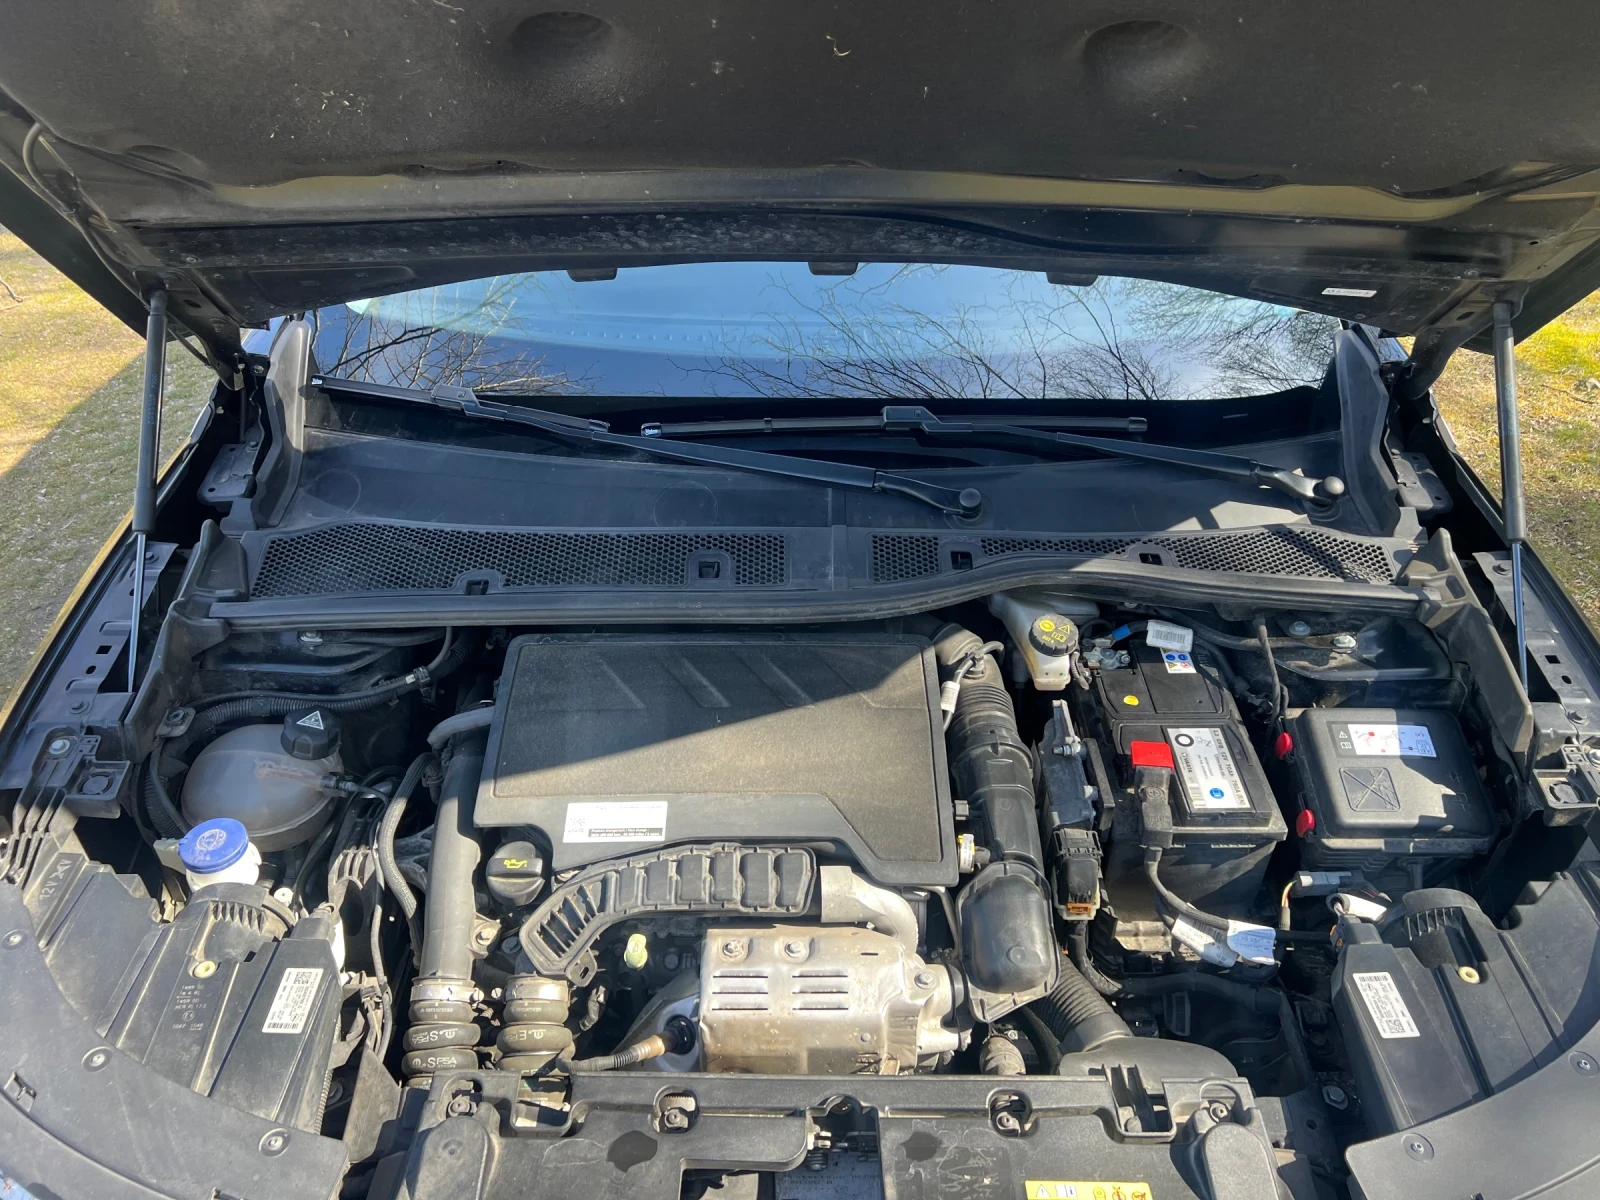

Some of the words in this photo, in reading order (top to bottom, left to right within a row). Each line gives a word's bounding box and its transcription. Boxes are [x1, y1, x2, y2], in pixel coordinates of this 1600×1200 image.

[40, 881, 58, 900] 12V
[411, 1035, 430, 1044] PSA
[436, 1056, 457, 1065] PSA
